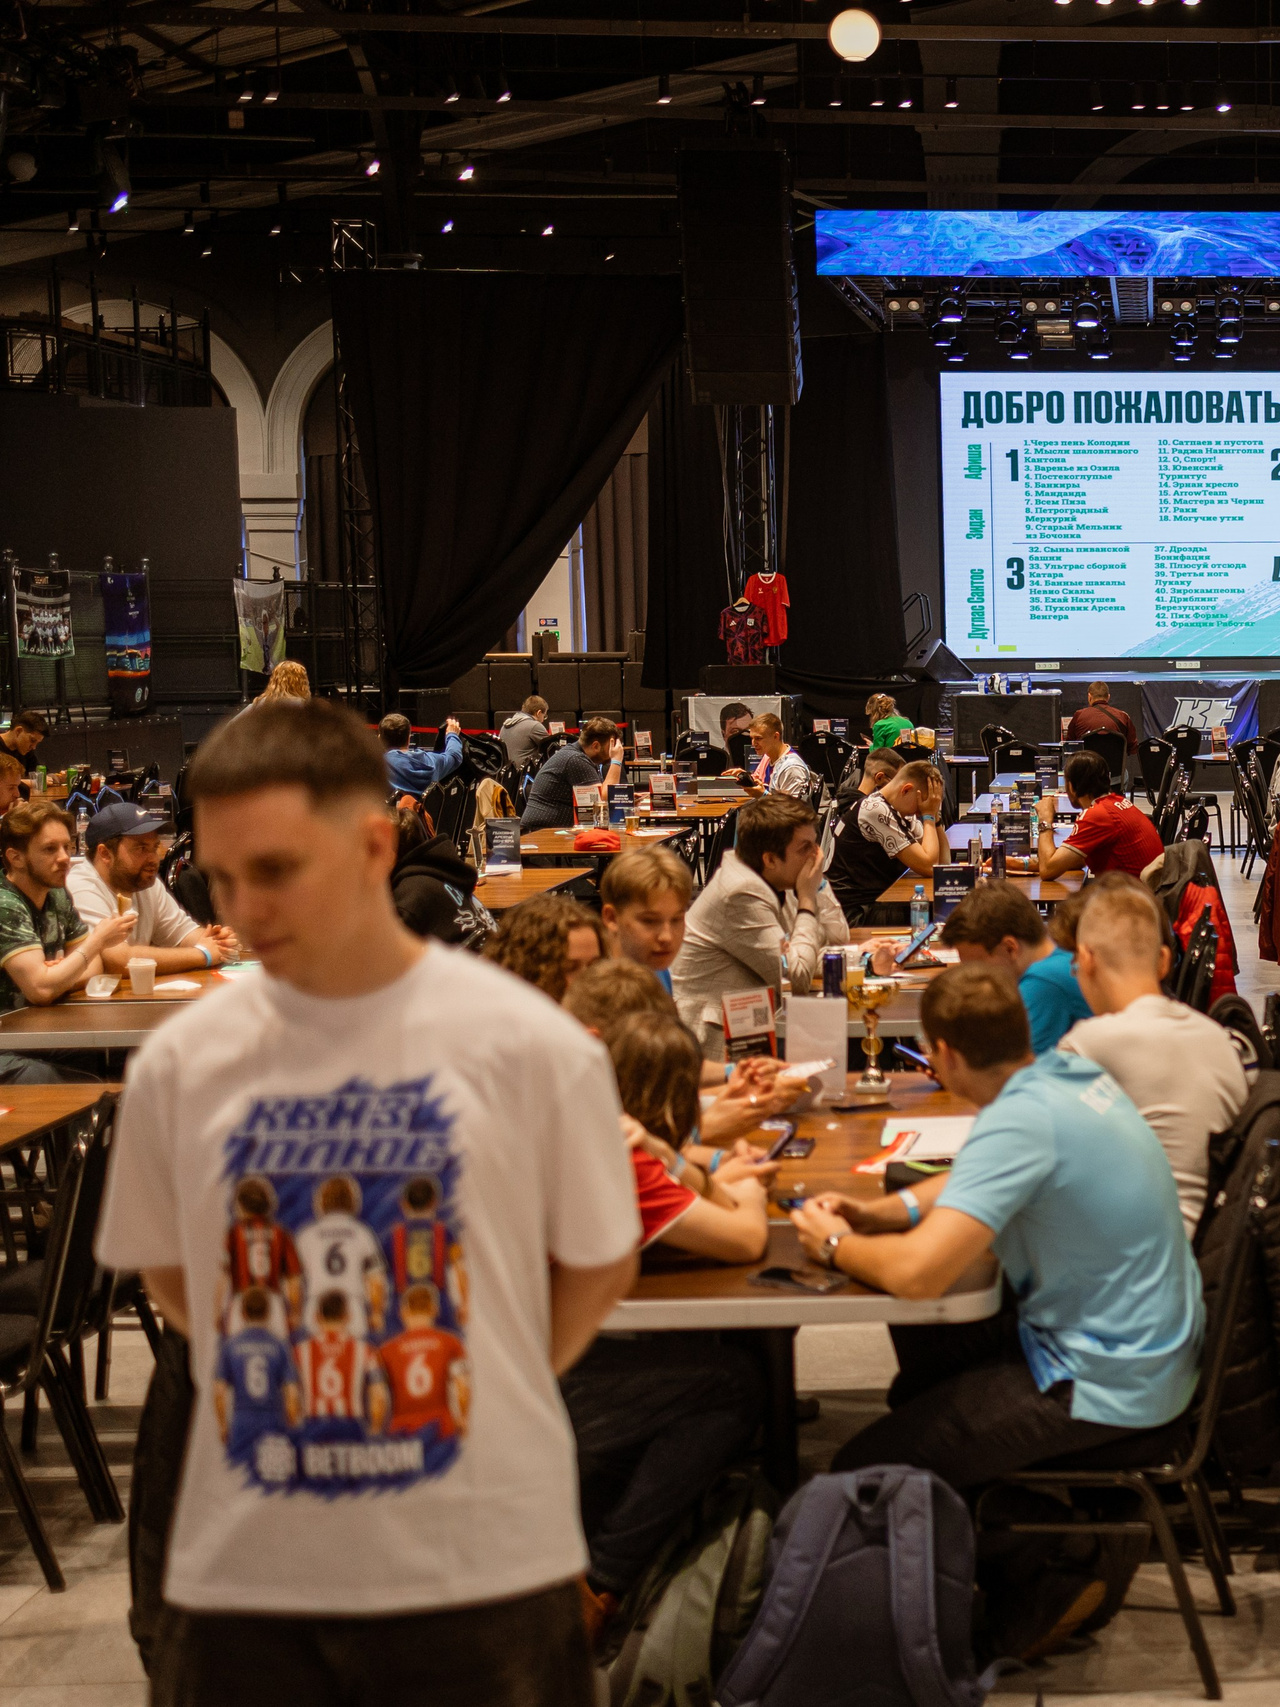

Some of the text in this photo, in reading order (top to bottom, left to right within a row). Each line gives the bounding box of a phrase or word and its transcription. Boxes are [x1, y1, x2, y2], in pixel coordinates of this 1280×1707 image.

[962, 390, 1064, 428] ДОБРО
[964, 444, 986, 480] Афиша
[1006, 449, 1018, 481] 1
[966, 509, 985, 539] Зидан
[1007, 557, 1024, 590] 3
[967, 568, 990, 640] Дуглас Сантос
[325, 1242, 346, 1276] 6
[245, 1355, 268, 1398] 6
[317, 1357, 344, 1398] 6
[405, 1354, 433, 1397] 6
